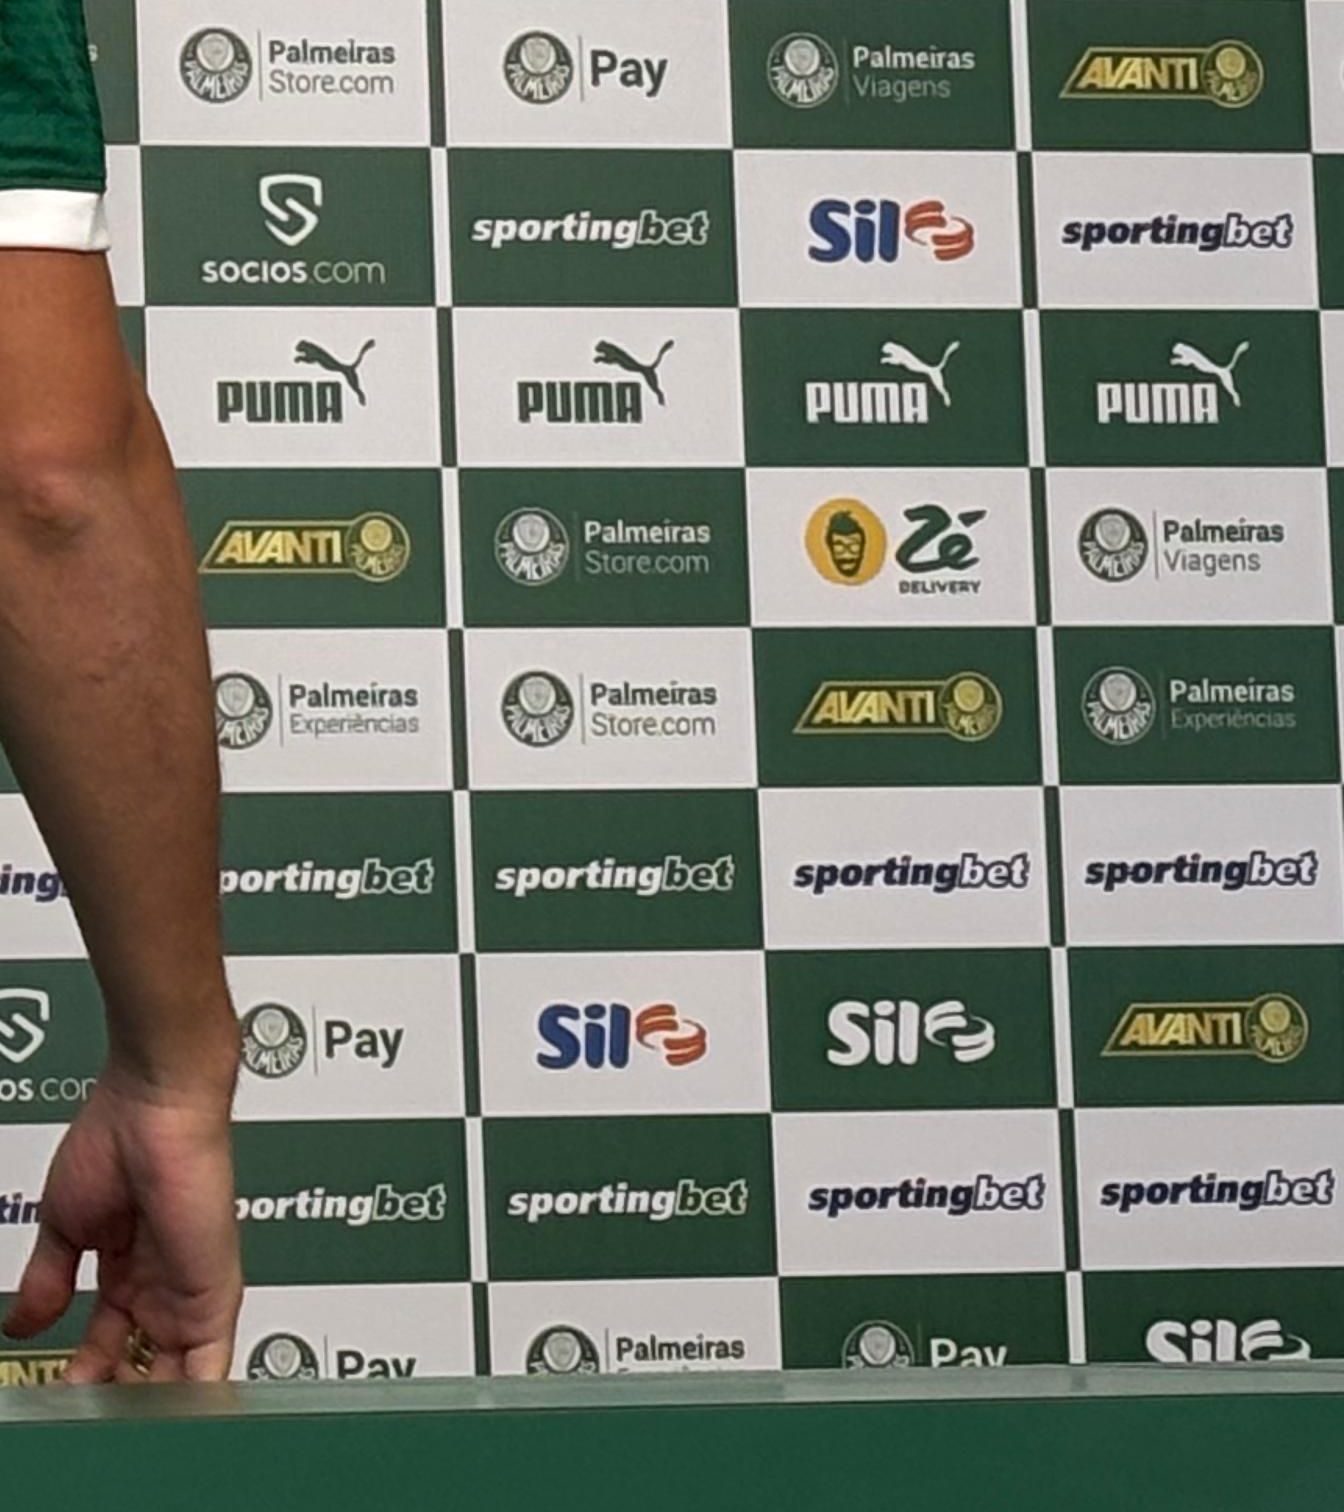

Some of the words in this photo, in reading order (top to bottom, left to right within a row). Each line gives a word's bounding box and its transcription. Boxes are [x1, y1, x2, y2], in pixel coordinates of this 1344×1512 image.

[269, 39, 395, 64] Palmeiras
[853, 45, 975, 69] Palmeiras
[269, 69, 394, 94] Store.com
[591, 50, 667, 97] Pay
[1074, 55, 1197, 89] AVANTI
[472, 210, 709, 249] sportingbet
[809, 199, 900, 263] Sil
[1063, 213, 1293, 252] sportingbet
[217, 381, 342, 423] PUMA
[518, 382, 642, 423] PUMA
[806, 382, 928, 423] PUMA
[1097, 383, 1218, 423] PUMA
[217, 531, 341, 563] AVANTI
[585, 520, 710, 543] Palmeiras
[1164, 518, 1284, 542] Palmeiras
[585, 550, 709, 574] Store.com
[1164, 550, 1261, 577] Viagens
[899, 580, 981, 594] DELIVERY
[290, 683, 418, 707] Palmeiras
[591, 681, 717, 706] Palmeiras
[812, 687, 934, 723] AVANTI
[1170, 678, 1294, 702] Palmeiras
[290, 713, 419, 738] Experiências
[592, 712, 715, 736] Store.com
[496, 855, 734, 897] sportingbet
[795, 853, 1029, 894] sportingbet
[1085, 851, 1318, 891] sportingbet
[325, 1021, 403, 1068] Pay
[537, 1003, 631, 1069] Sil
[828, 1000, 919, 1065] Sil
[1121, 1012, 1241, 1045] AVANTI
[508, 1179, 748, 1222] sportingbet
[809, 1174, 1045, 1217] sportingbet
[1101, 1169, 1334, 1212] sportingbet
[617, 1334, 744, 1361] Palmeiras
